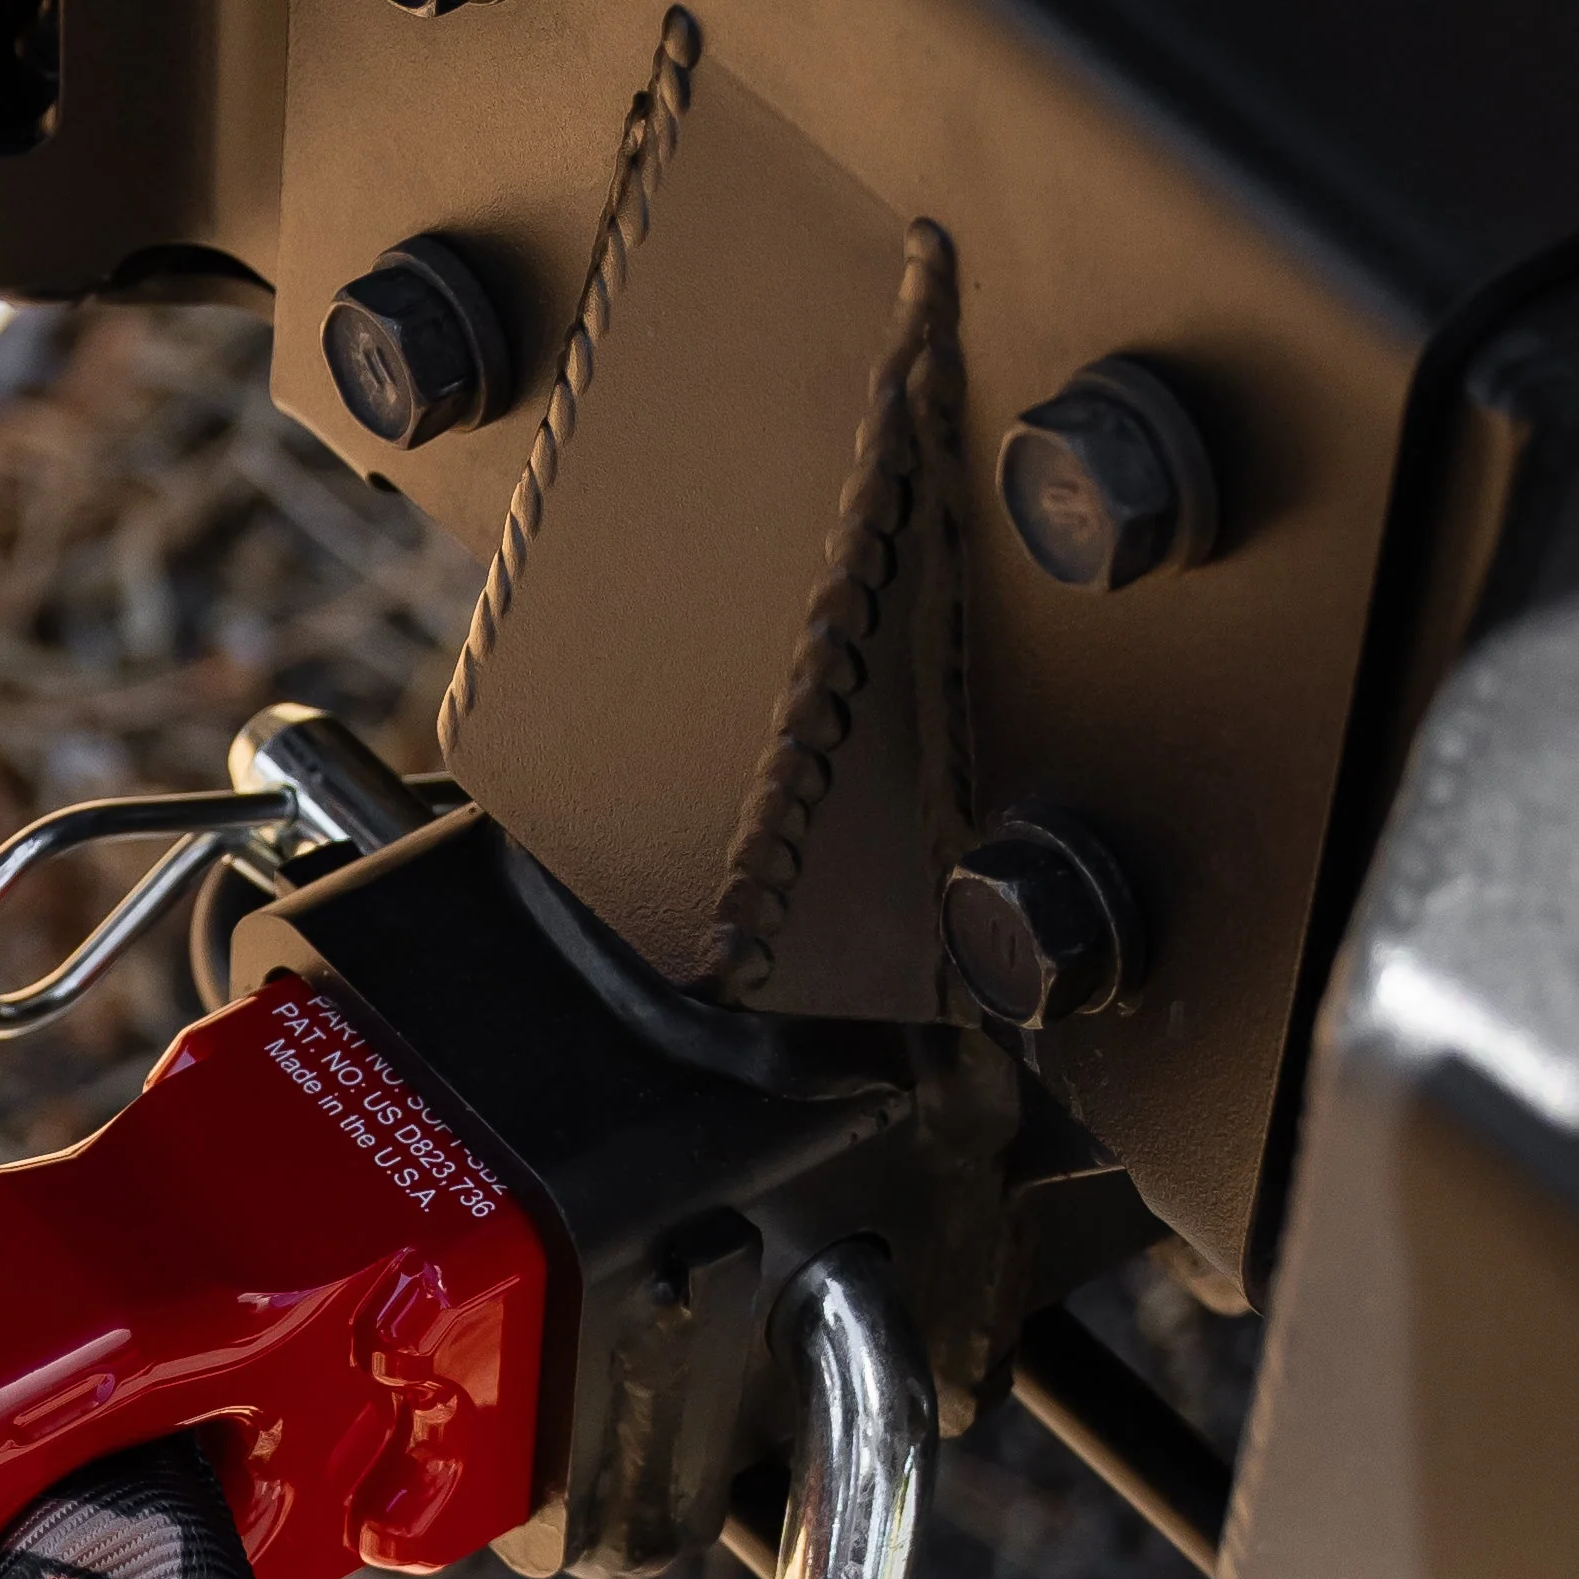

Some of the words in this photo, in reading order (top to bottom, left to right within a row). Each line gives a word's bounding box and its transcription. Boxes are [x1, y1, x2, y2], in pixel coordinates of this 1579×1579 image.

[264, 1038, 322, 1094] Made
[318, 1092, 343, 1116] in
[340, 1114, 376, 1148] the
[374, 1147, 436, 1213] U.S.A.
[271, 1002, 327, 1052] PAT.
[320, 1050, 366, 1093] NO:
[363, 1091, 402, 1125] US
[394, 1124, 496, 1217] D823,736
